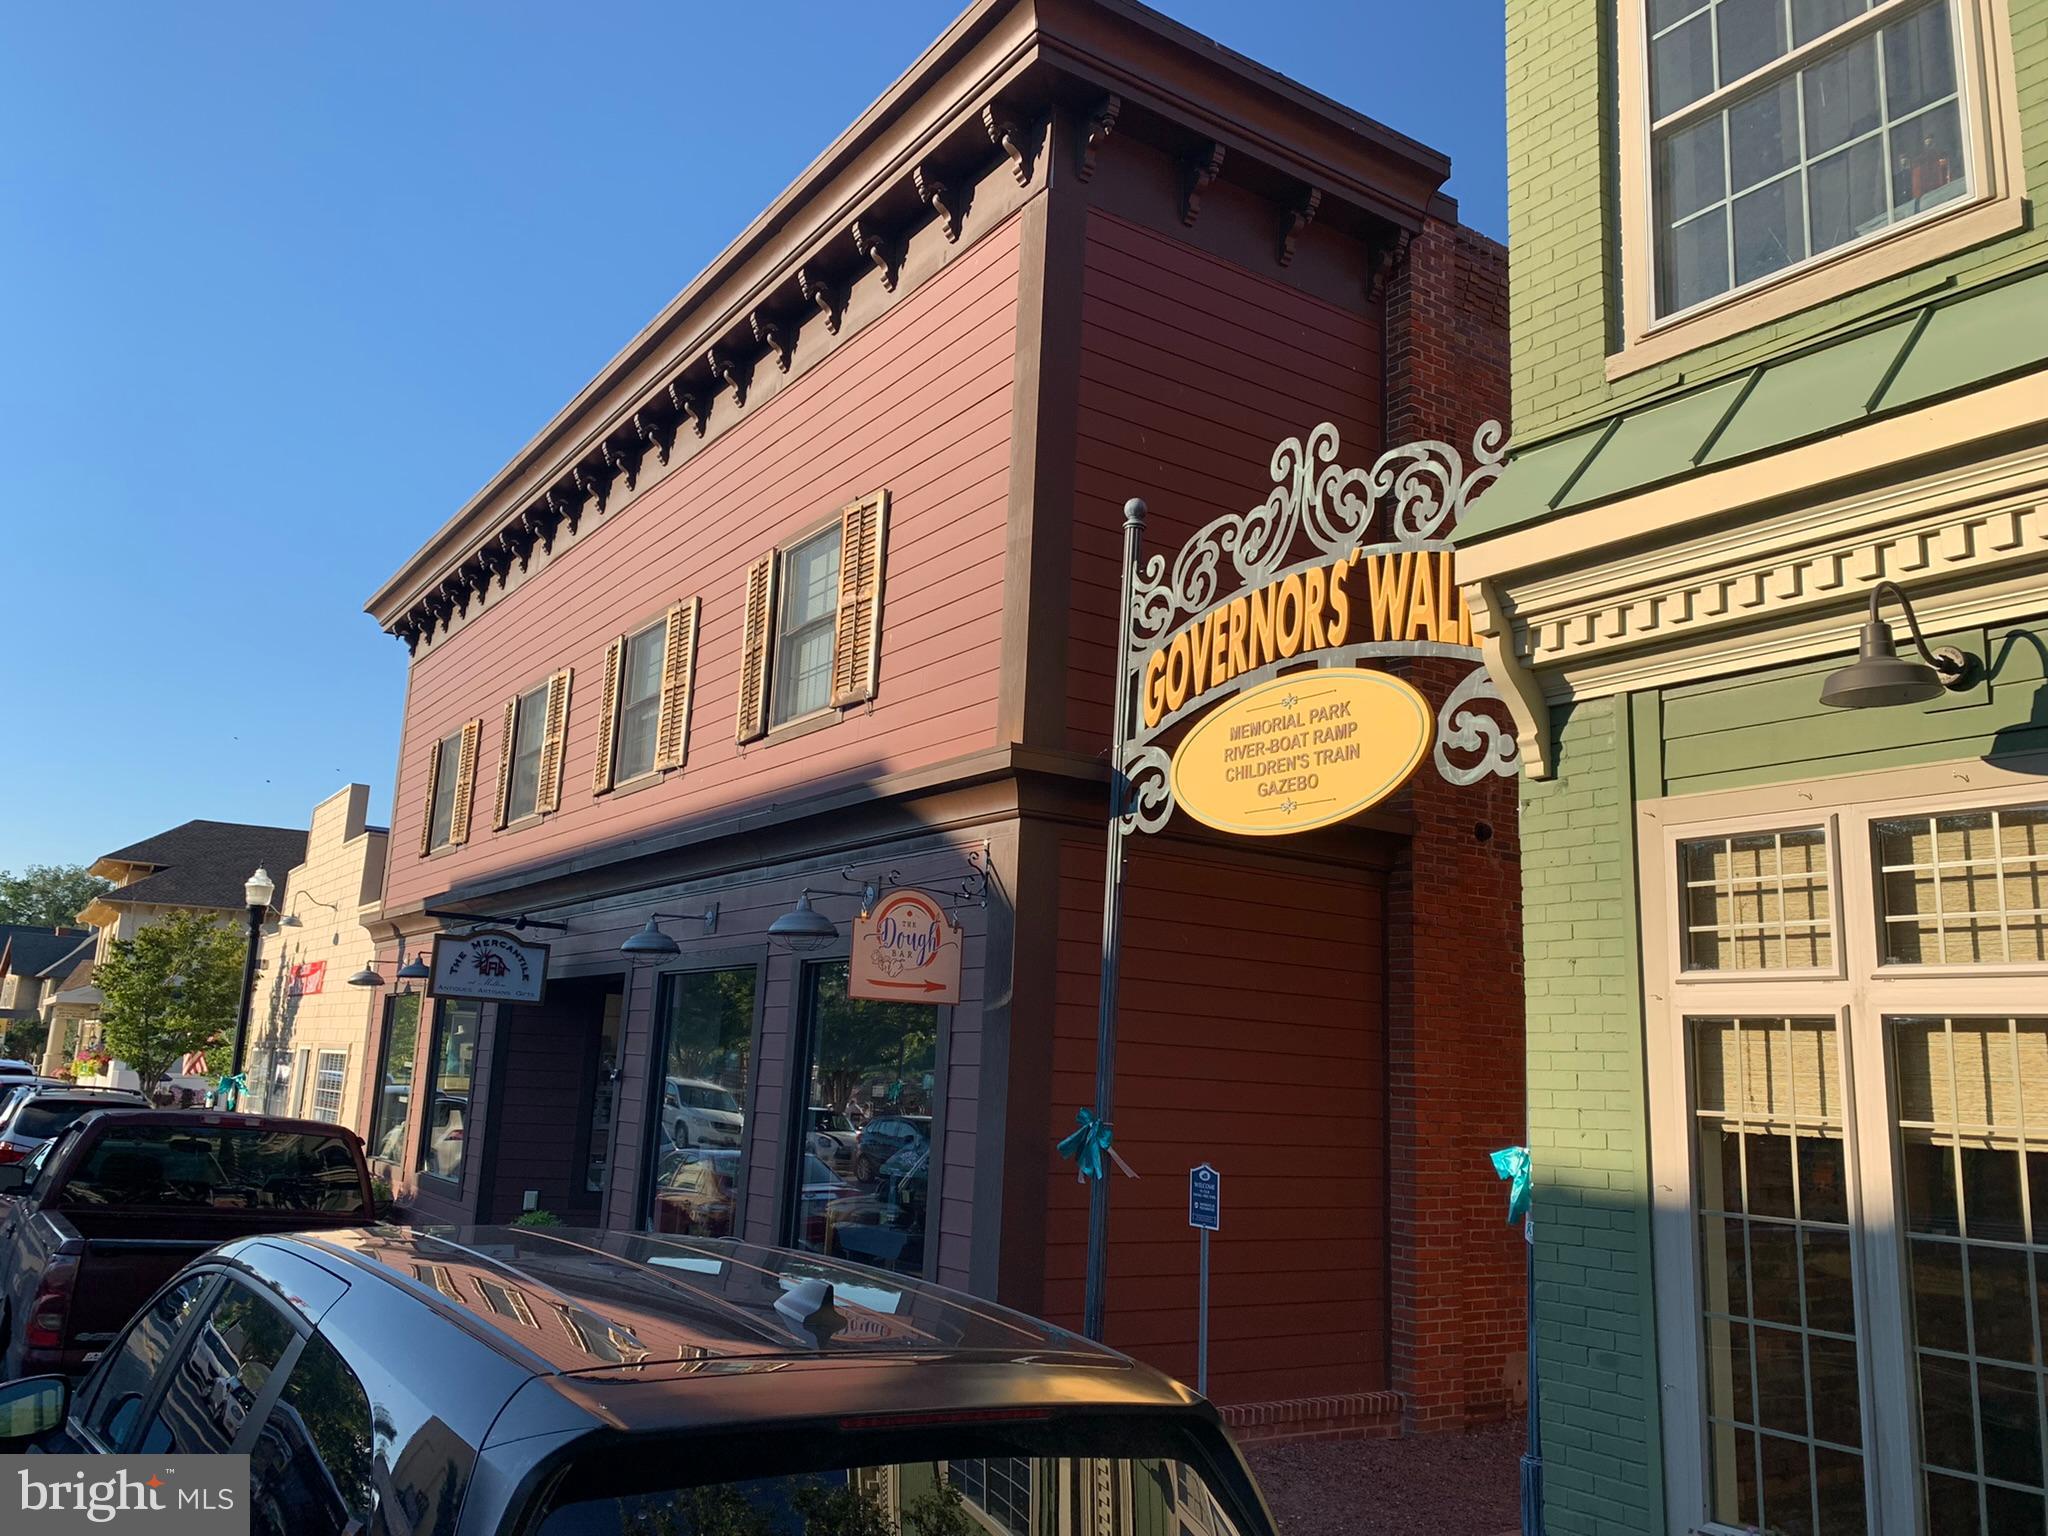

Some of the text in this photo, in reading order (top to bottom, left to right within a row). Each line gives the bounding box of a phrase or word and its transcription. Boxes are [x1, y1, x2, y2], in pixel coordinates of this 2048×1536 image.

[1143, 547, 1362, 727] GOVERNORS'
[1230, 700, 1351, 741] MEMORIAL PARK
[1224, 722, 1358, 762] RIVER-BOAT RAMP
[1226, 743, 1360, 782] CHILDREN'S TRAIN
[1258, 774, 1319, 797] GAZEBO
[879, 917, 939, 966] Dough
[902, 920, 917, 929] THE
[449, 939, 530, 981] THE MERCANTILE
[891, 950, 913, 959] BAR
